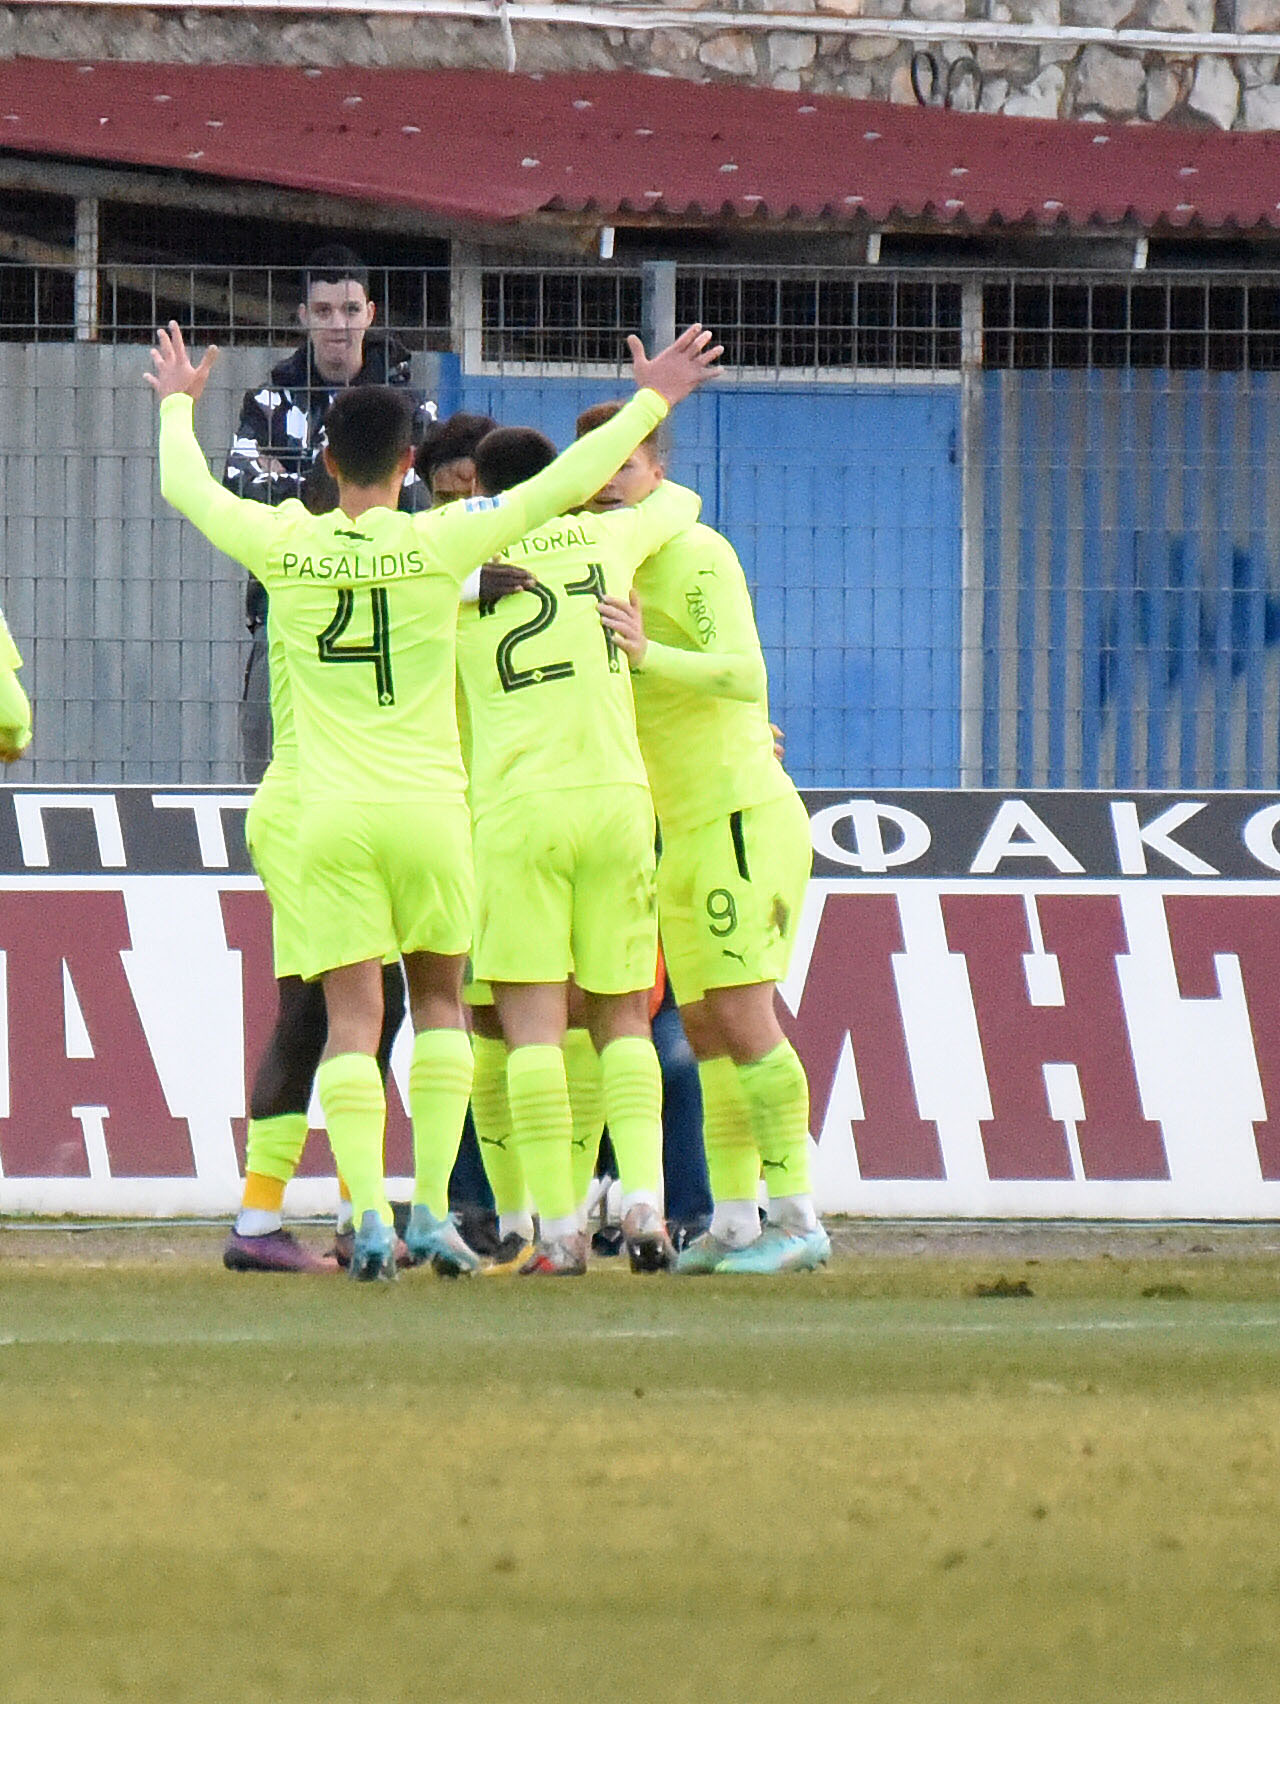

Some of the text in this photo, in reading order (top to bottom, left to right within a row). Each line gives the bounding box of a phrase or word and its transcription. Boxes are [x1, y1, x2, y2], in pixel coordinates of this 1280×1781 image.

[283, 550, 424, 578] PASALIDIS
[316, 587, 394, 706] 4
[479, 563, 620, 693] 21
[706, 888, 738, 938] 9
